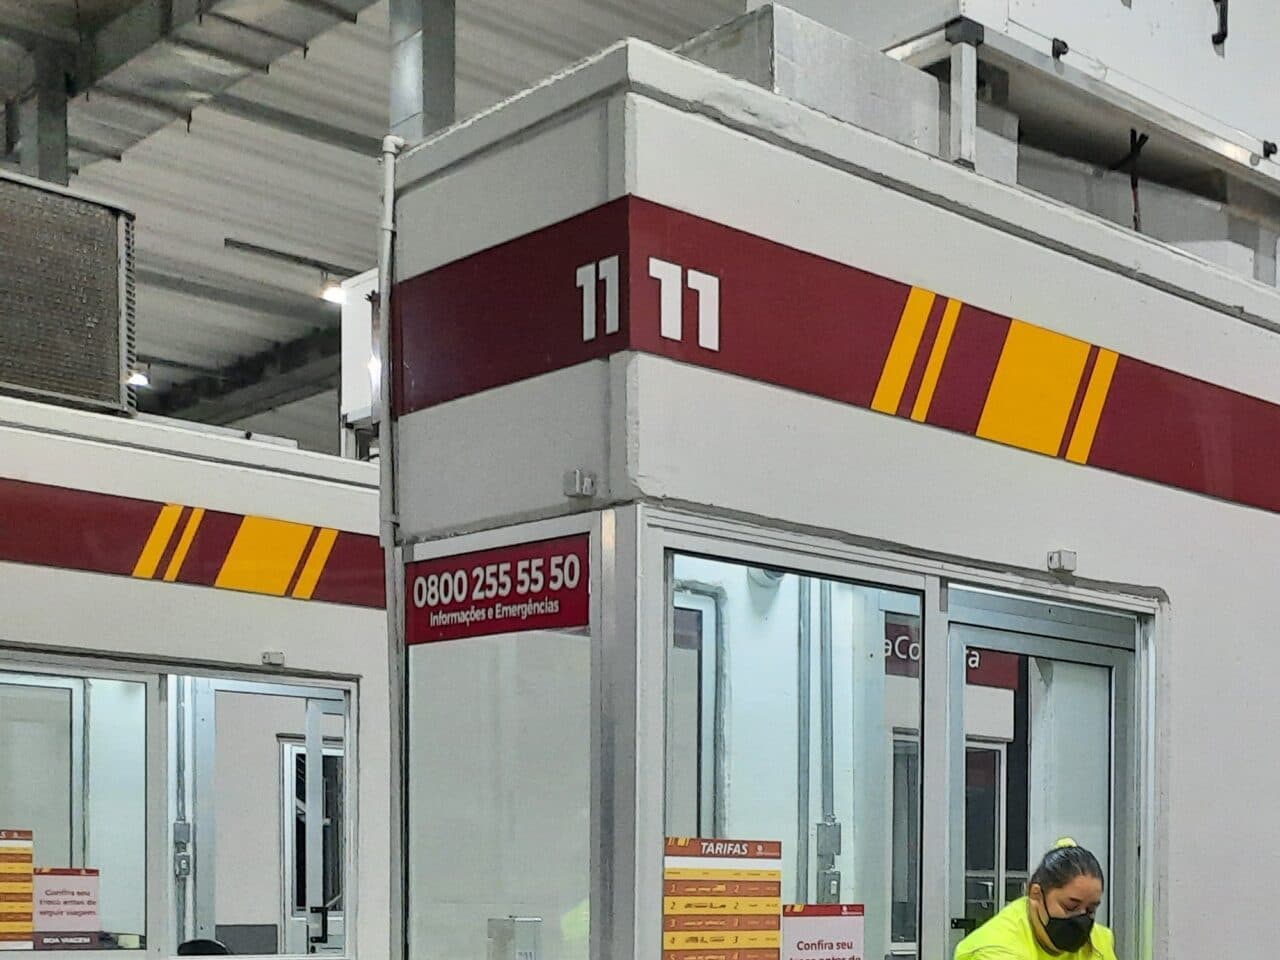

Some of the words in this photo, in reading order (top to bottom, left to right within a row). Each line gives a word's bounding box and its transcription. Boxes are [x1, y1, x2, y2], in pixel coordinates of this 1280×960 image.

[576, 255, 619, 342] 11
[649, 256, 720, 351] 11
[413, 570, 468, 608] 0800
[472, 562, 511, 601] 255
[516, 558, 544, 595] 55
[549, 554, 580, 590] 50
[430, 605, 486, 627] Informações
[487, 610, 493, 619] e
[495, 597, 559, 620] Emergências
[701, 842, 748, 855] TARIFAS
[797, 939, 833, 951] Confira
[836, 941, 853, 950] seu
